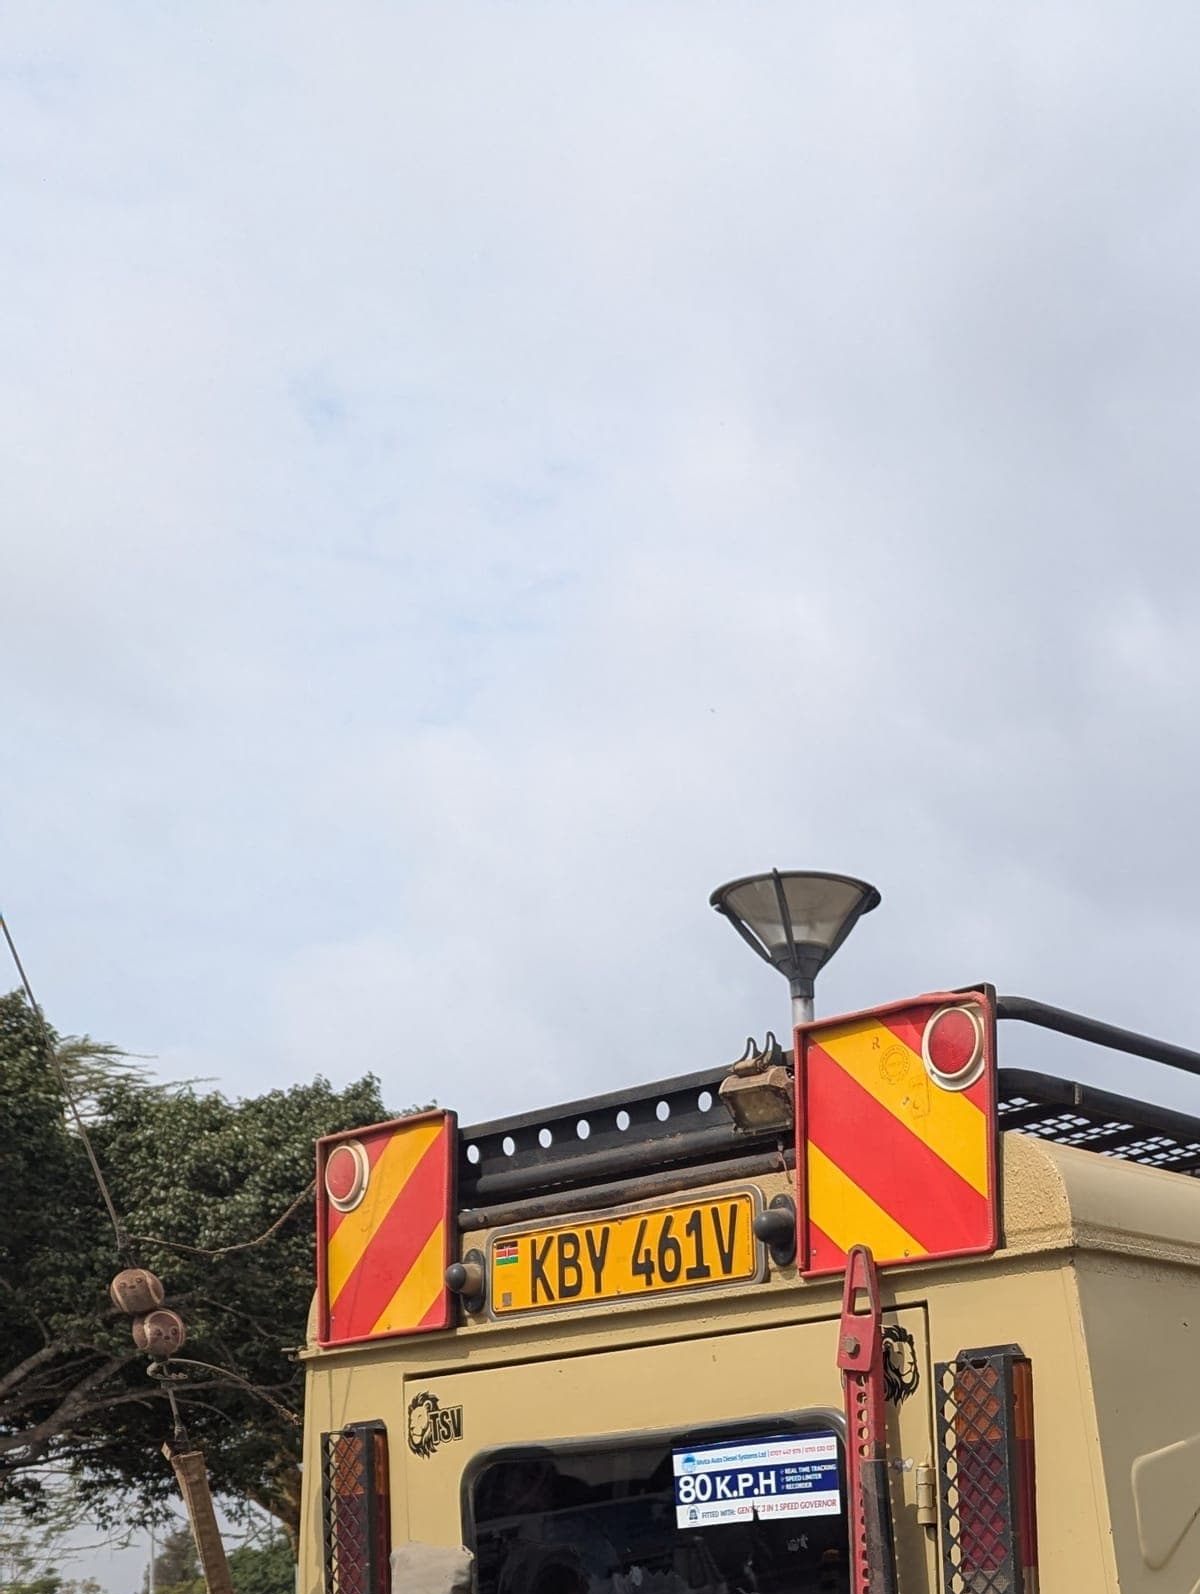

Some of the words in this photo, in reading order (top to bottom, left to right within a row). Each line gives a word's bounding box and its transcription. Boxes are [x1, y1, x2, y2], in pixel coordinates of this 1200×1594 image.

[530, 1227, 609, 1303] KBY
[631, 1204, 738, 1286] 461V
[429, 1406, 463, 1444] TSV
[811, 1463, 837, 1472] TRACKING
[678, 1474, 712, 1503] 80
[715, 1470, 777, 1499] K.P.H
[701, 1510, 719, 1519] FITTED
[779, 1502, 799, 1511] SPEED
[800, 1499, 837, 1509] GOVERNOR
